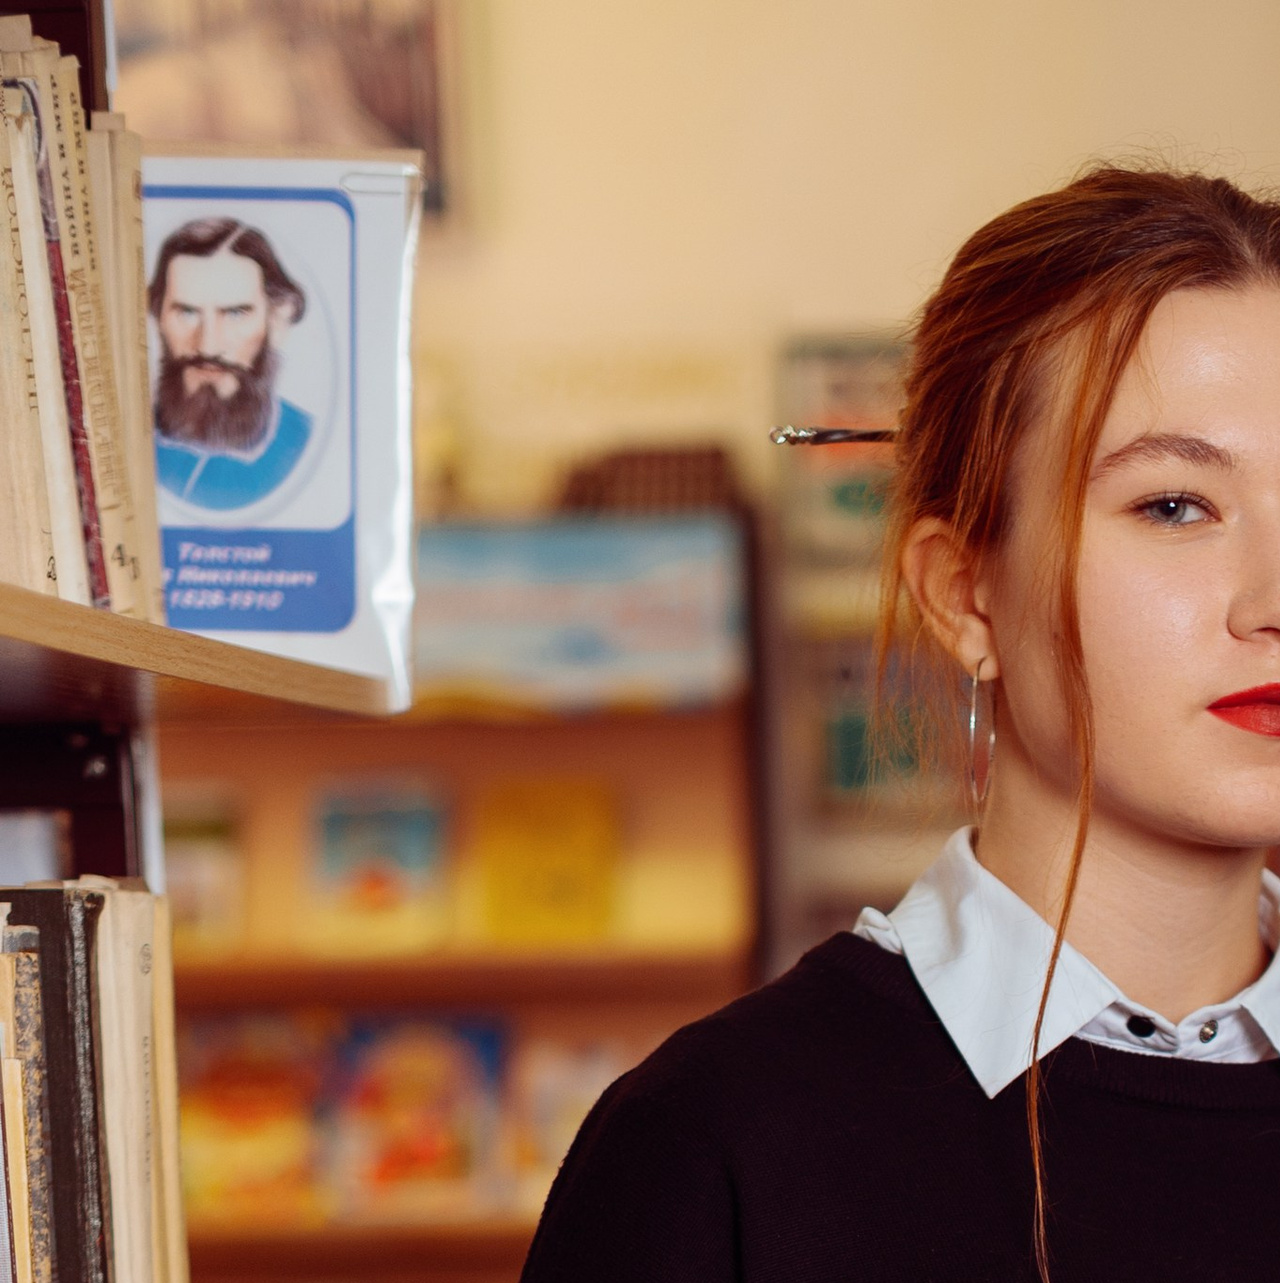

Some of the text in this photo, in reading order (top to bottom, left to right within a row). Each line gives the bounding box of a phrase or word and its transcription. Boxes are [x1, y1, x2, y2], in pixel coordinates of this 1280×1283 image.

[50, 74, 62, 133] МИР
[69, 91, 83, 150] МИР
[61, 169, 81, 257] ВОЙНА
